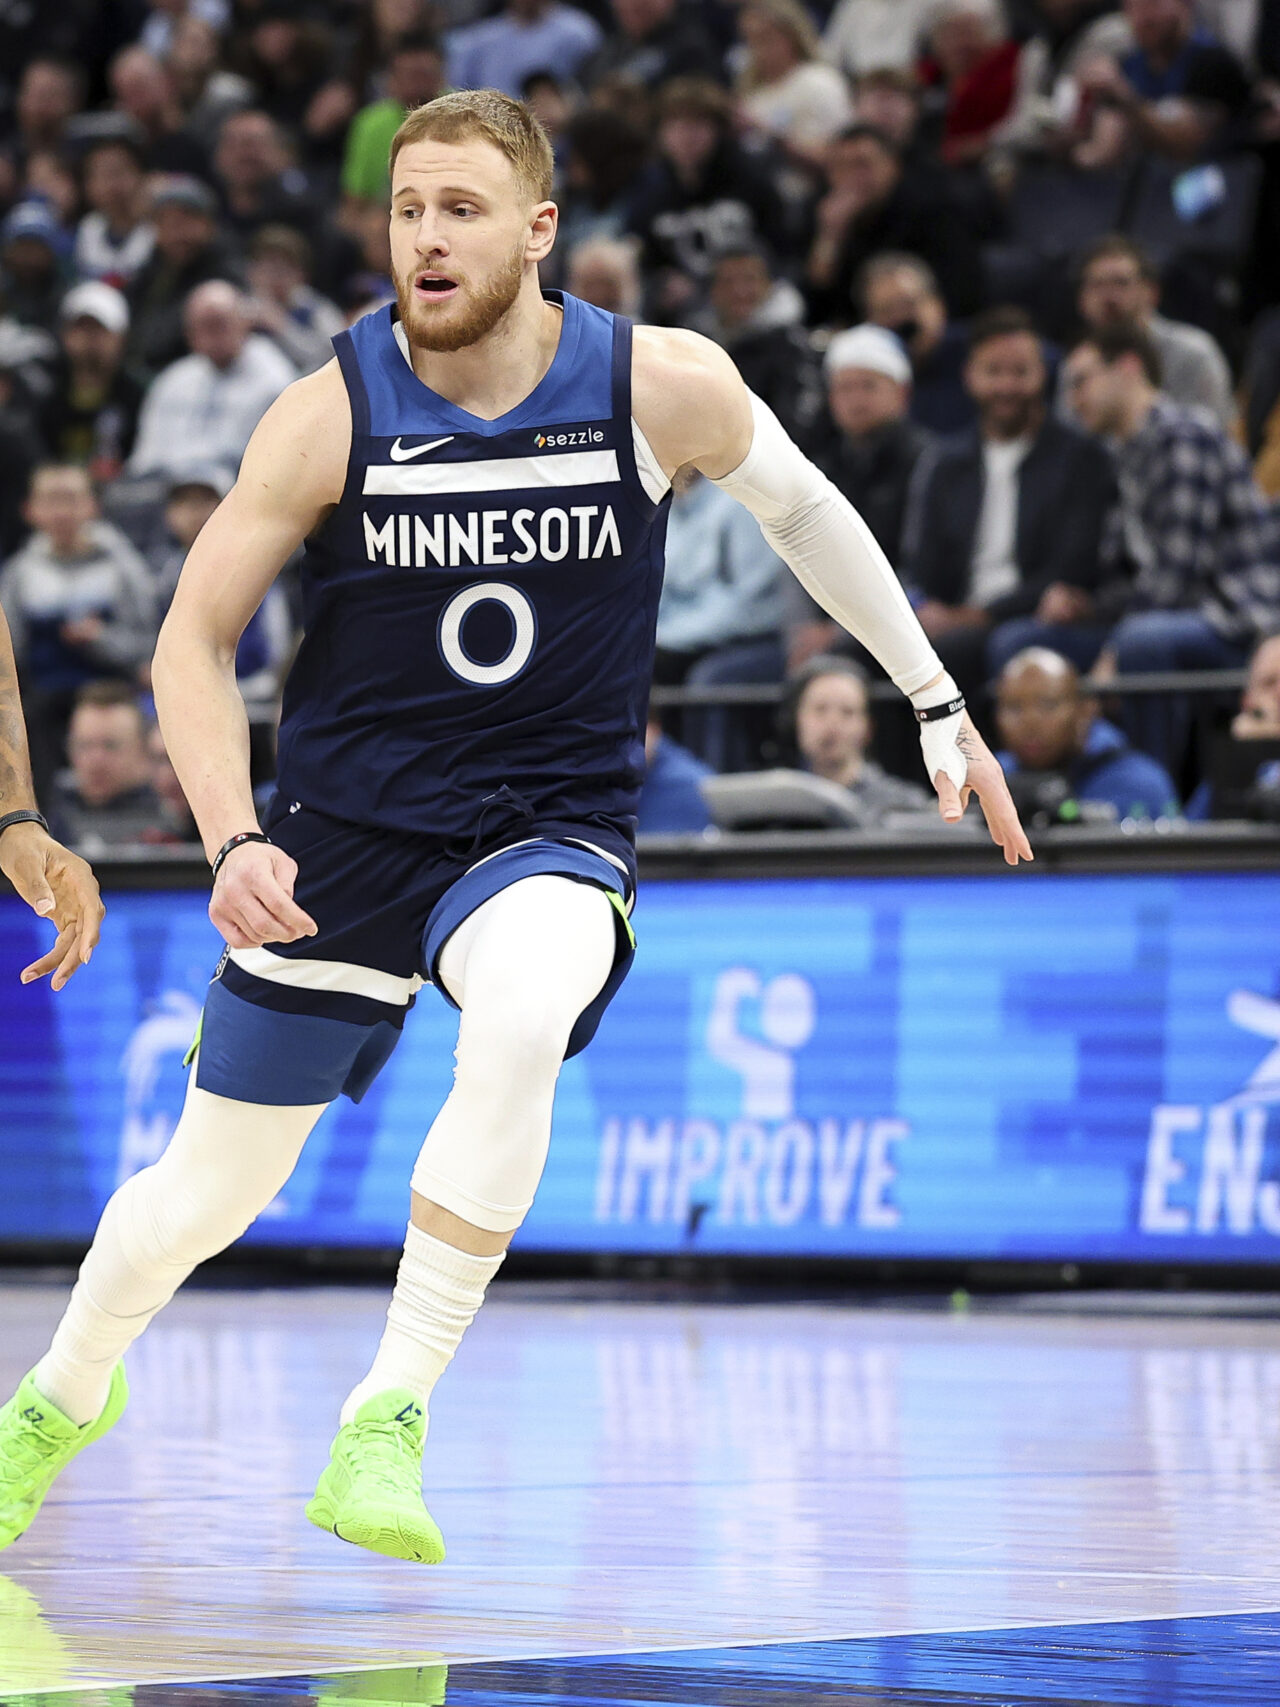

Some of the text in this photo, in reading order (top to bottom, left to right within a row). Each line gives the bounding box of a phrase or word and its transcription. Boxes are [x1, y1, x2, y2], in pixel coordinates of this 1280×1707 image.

[546, 427, 604, 447] sezzle
[362, 505, 622, 567] MINNESOTA
[436, 580, 538, 688] 0
[594, 1114, 908, 1230] IMPROVE
